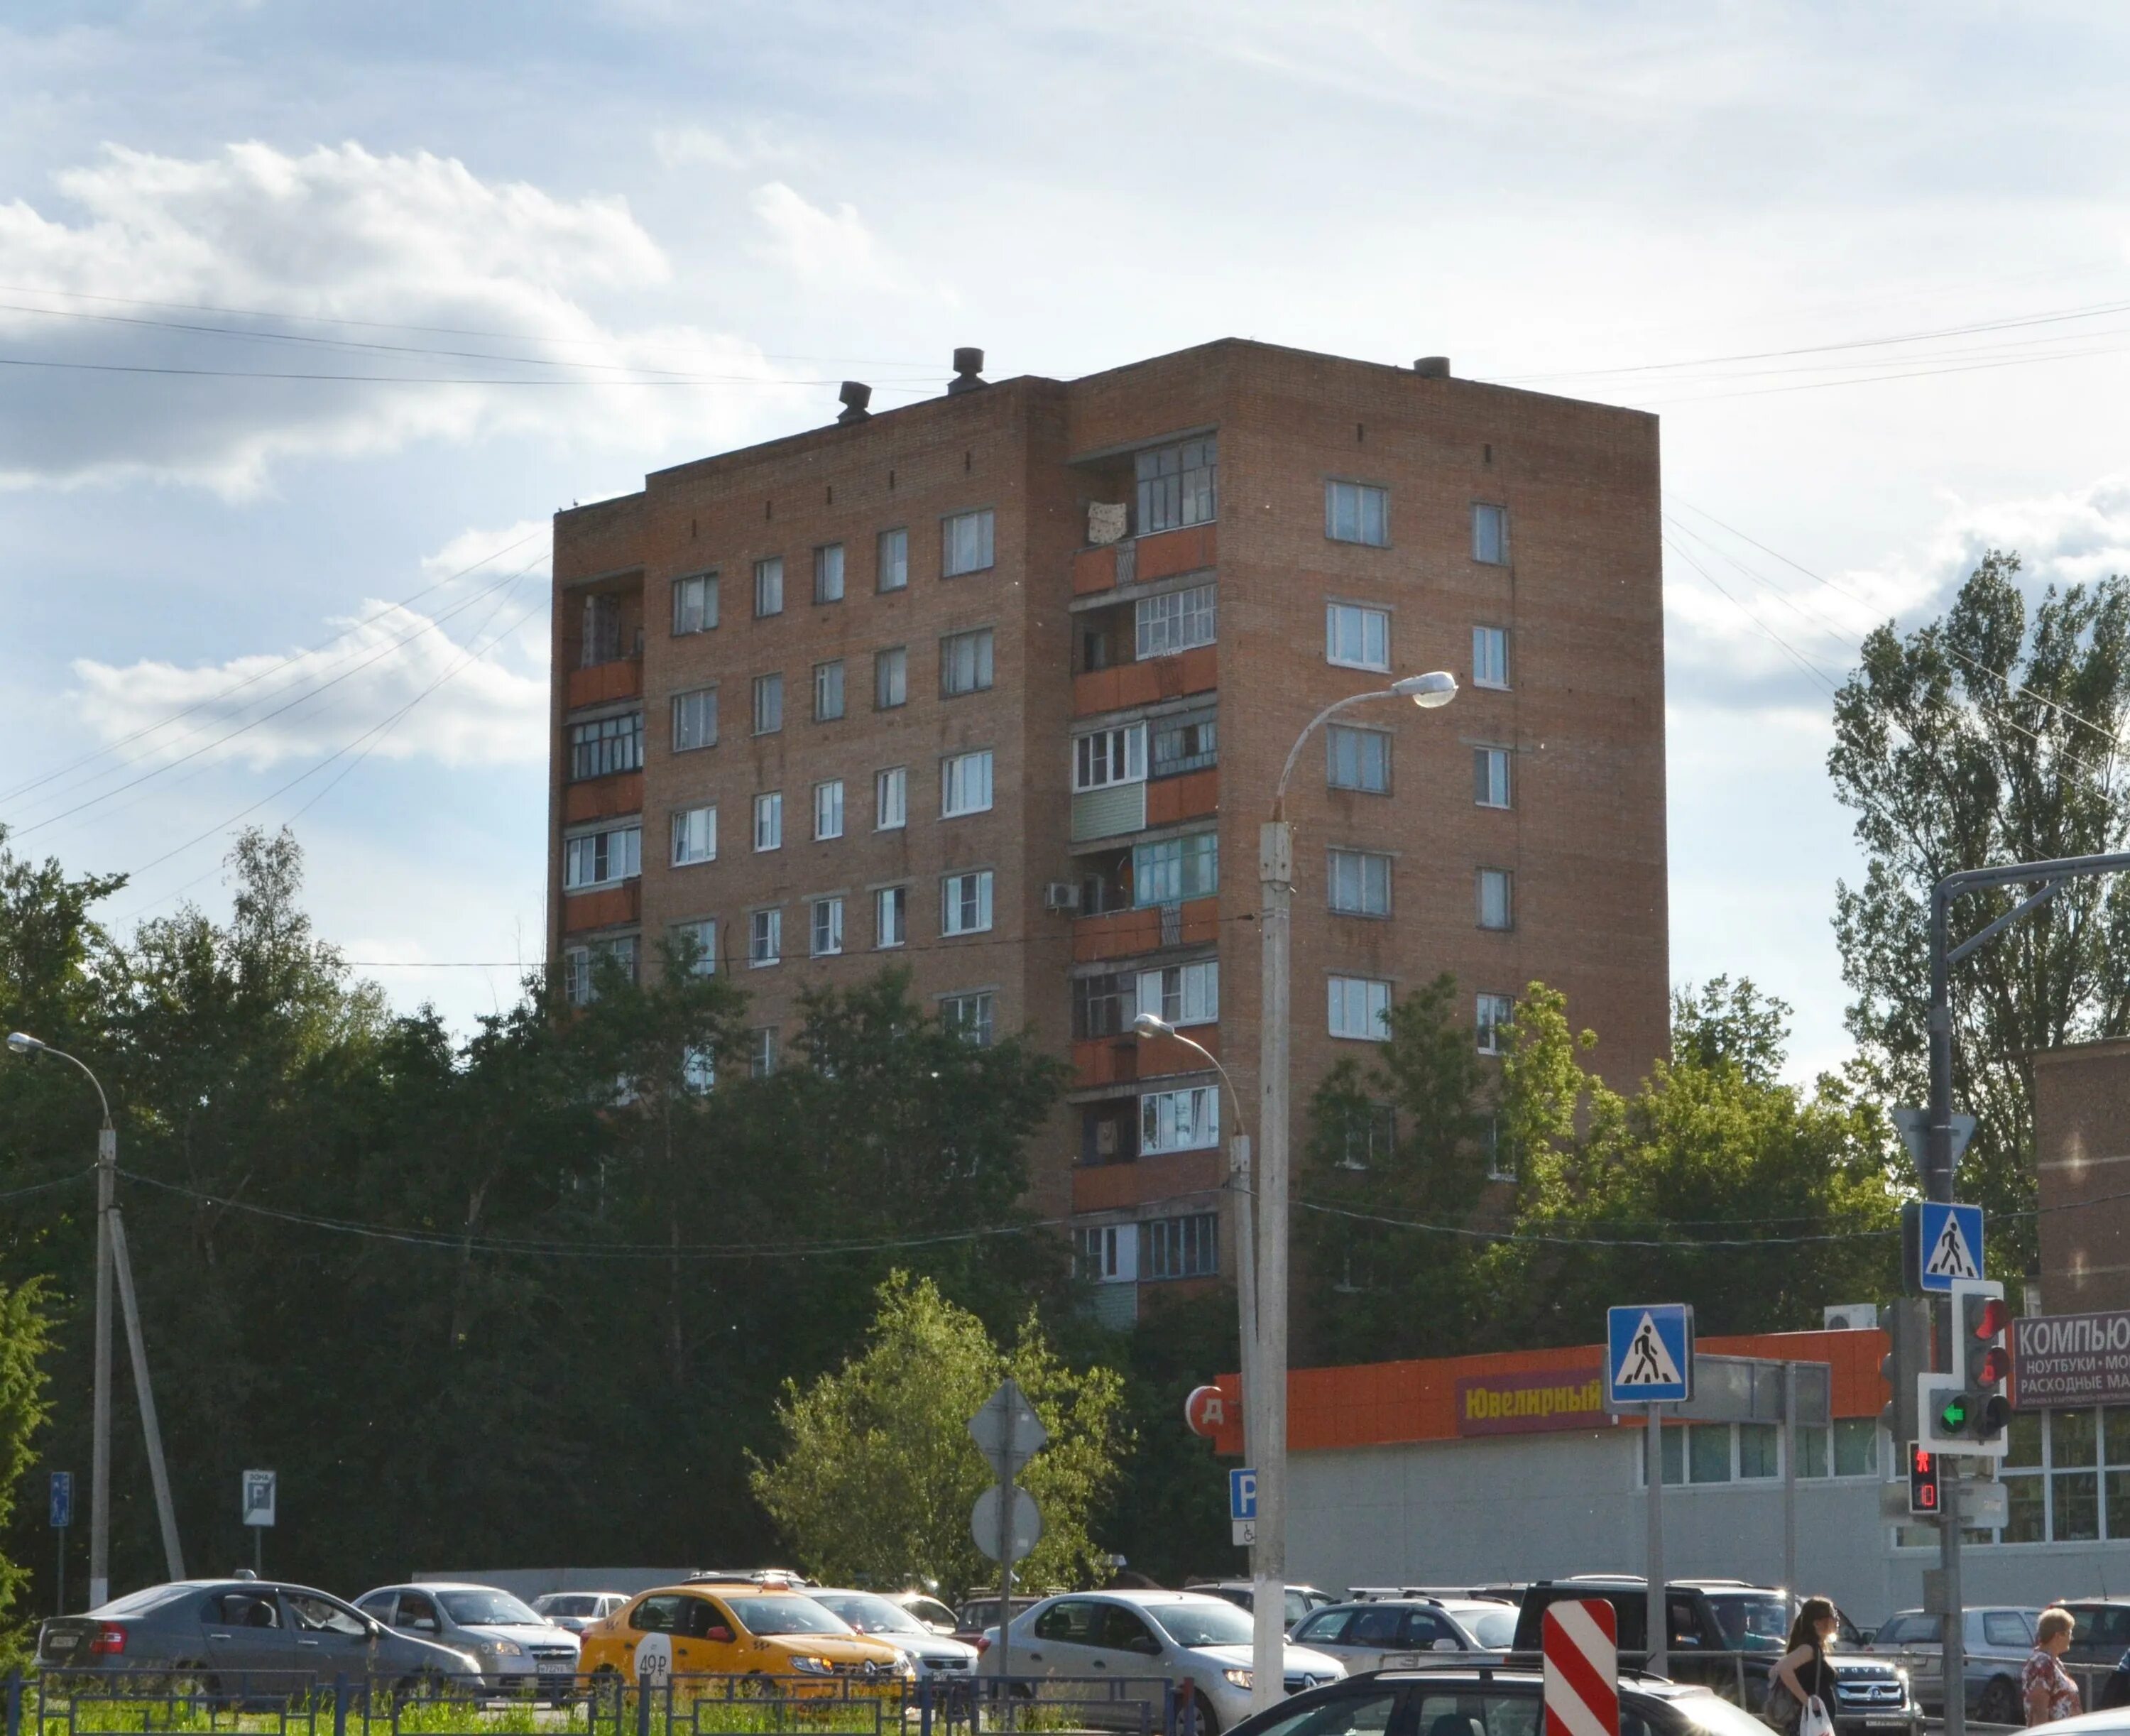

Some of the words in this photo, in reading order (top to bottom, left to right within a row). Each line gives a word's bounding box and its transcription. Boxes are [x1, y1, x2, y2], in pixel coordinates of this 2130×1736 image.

[2019, 1317, 2130, 1356] КОМПЬЮ
[2026, 1358, 2095, 1374] НОУТБУКИ
[2106, 1355, 2130, 1370] МО
[2021, 1376, 2103, 1392] РАСХОДНЫЕ
[1202, 1399, 1224, 1425] Д
[1466, 1379, 1602, 1419] Ювелирный
[253, 1485, 265, 1505] P
[1240, 1475, 1256, 1513] P
